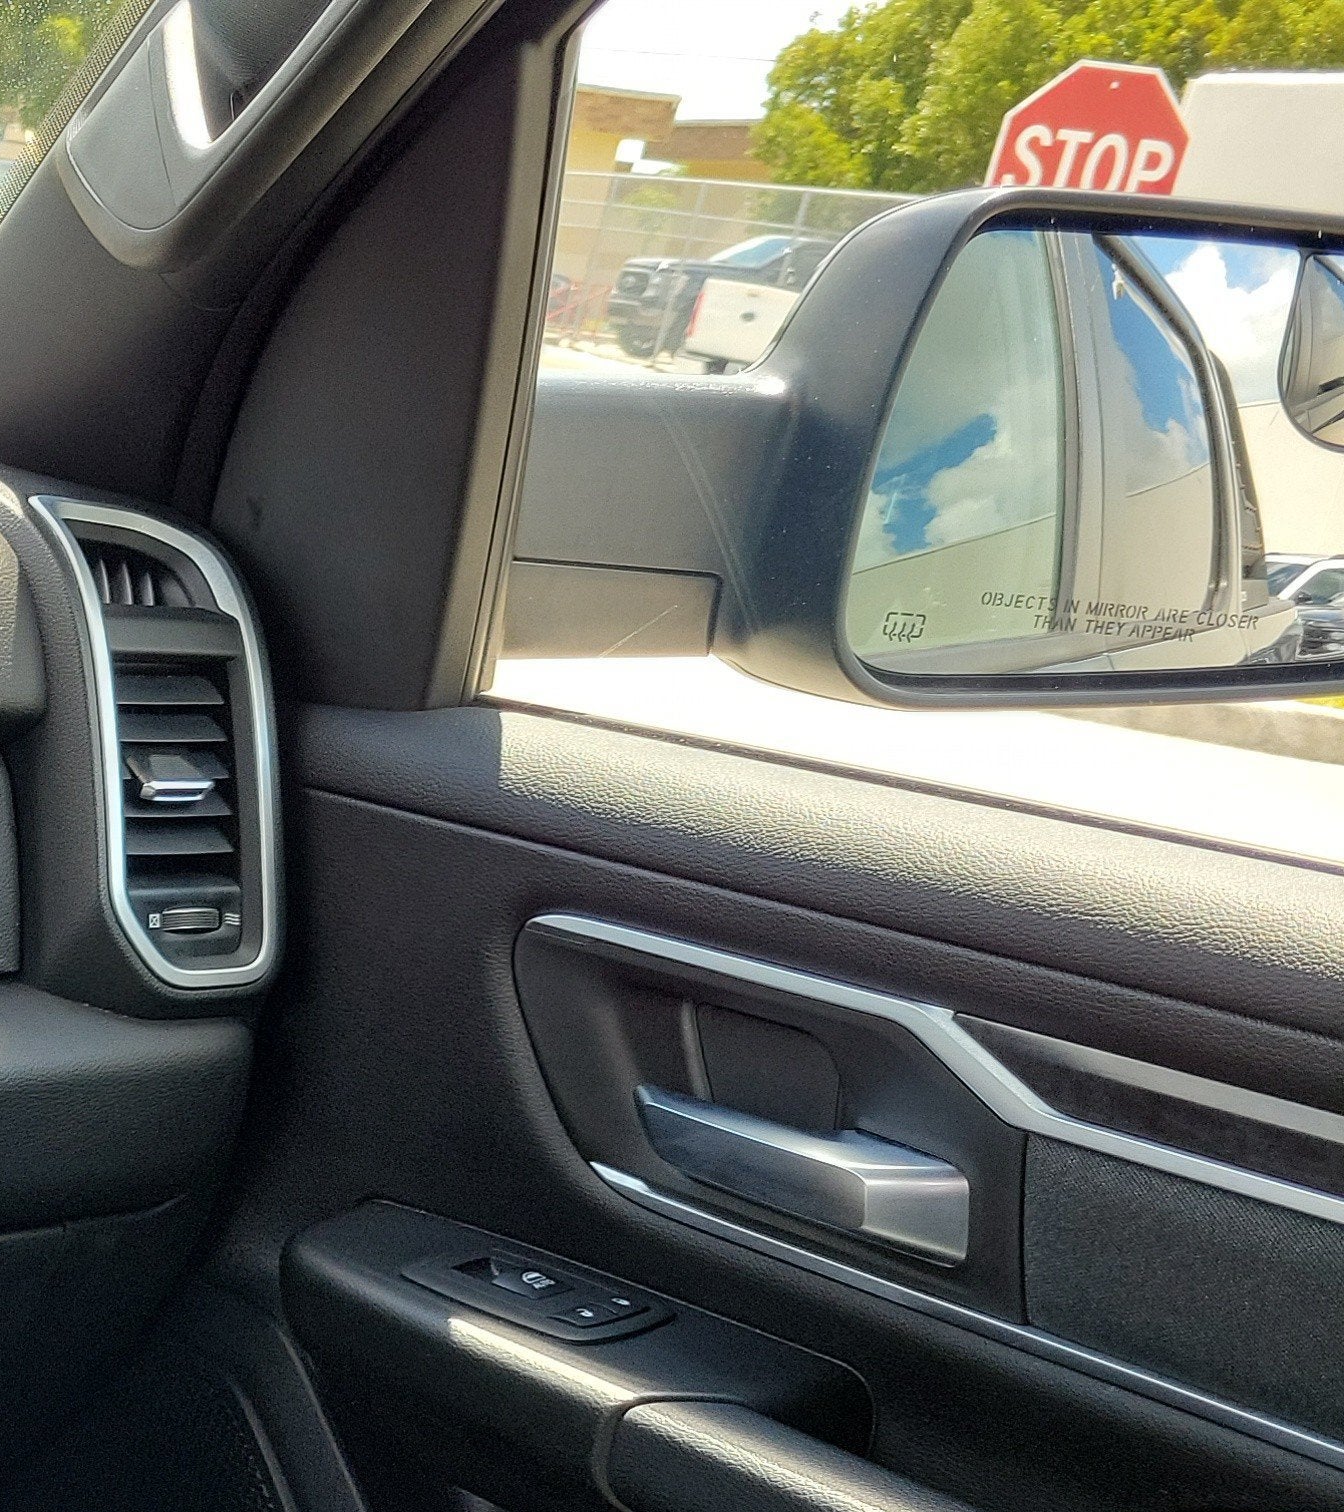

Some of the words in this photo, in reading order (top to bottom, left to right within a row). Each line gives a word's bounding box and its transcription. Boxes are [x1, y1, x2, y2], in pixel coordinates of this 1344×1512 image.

[1000, 124, 1176, 193] STOP
[980, 591, 1055, 612] OBJECTS
[1063, 598, 1079, 614] IN
[1085, 601, 1149, 620] MIRROR
[1154, 607, 1189, 624] ARE
[1196, 611, 1259, 630] CLOSER
[1033, 614, 1077, 632] THAN
[1085, 619, 1125, 636] THEY
[1128, 624, 1196, 642] APPEAR
